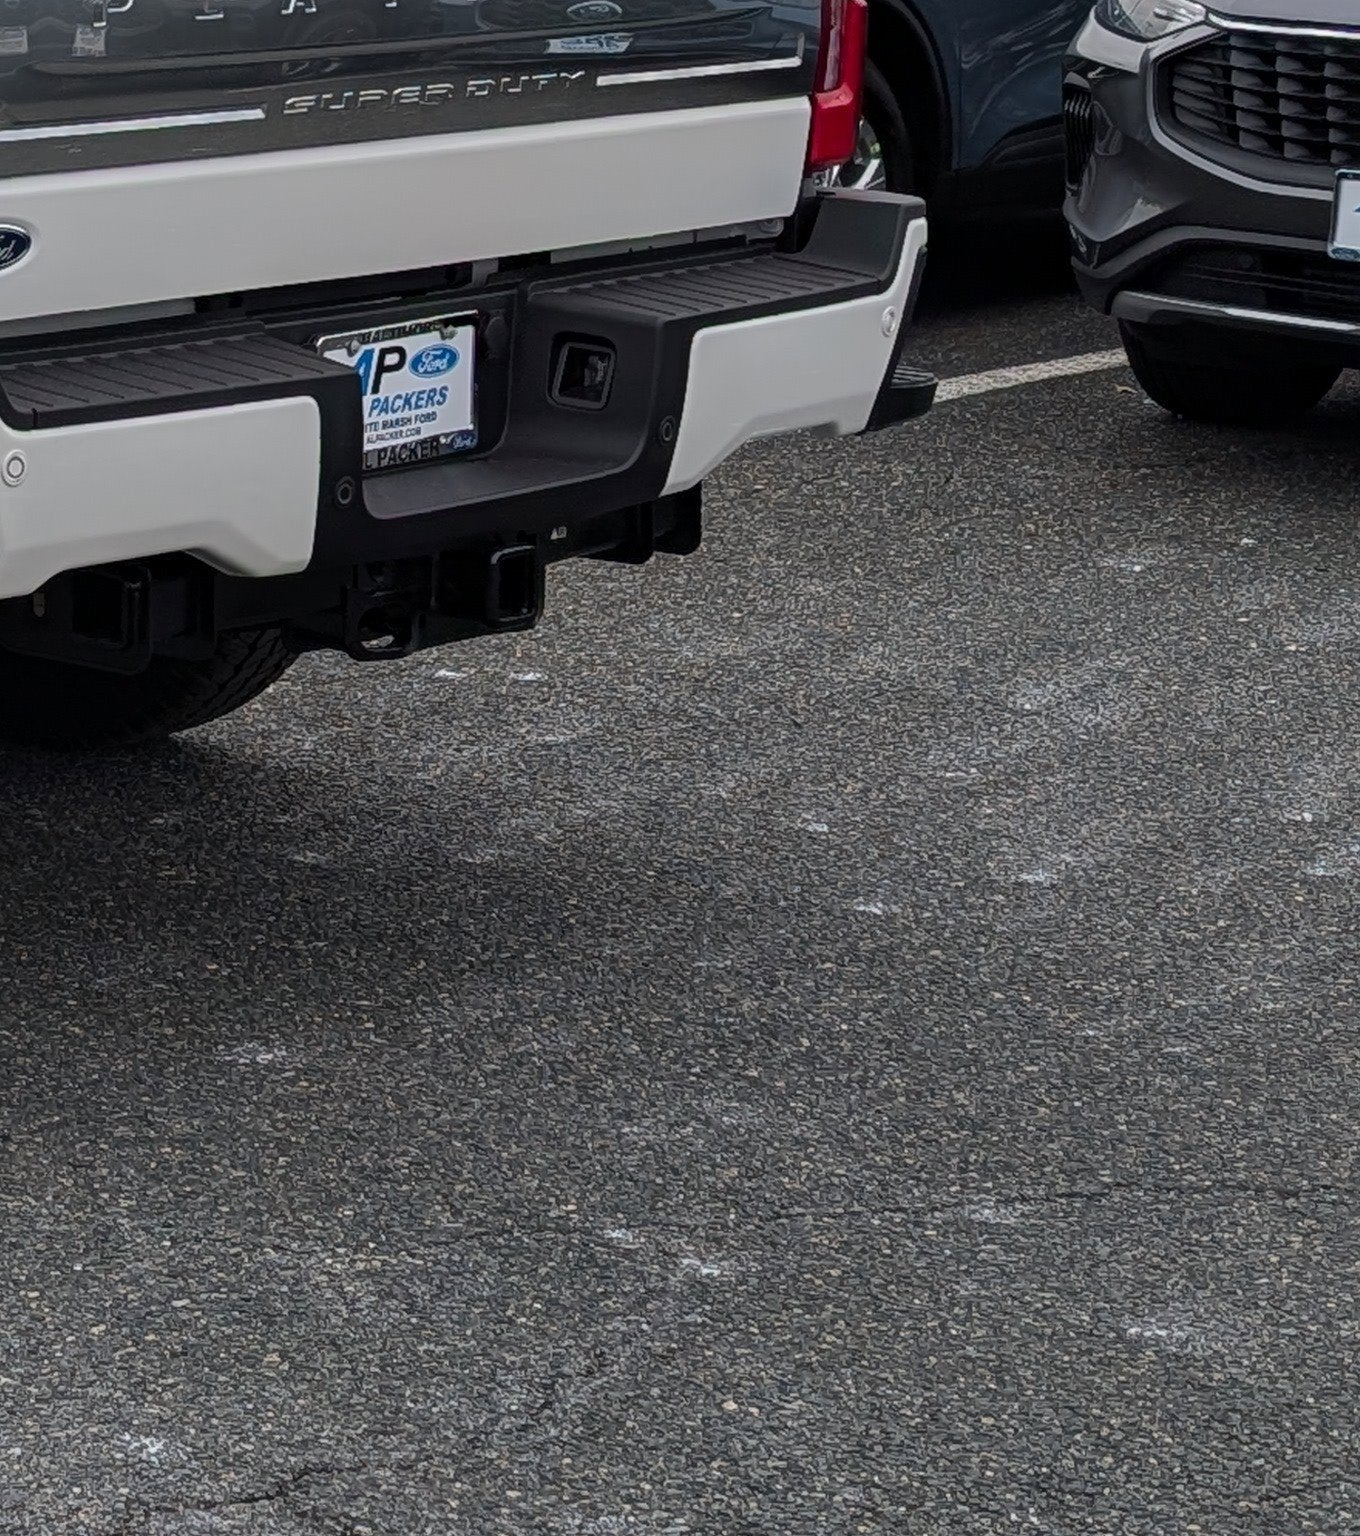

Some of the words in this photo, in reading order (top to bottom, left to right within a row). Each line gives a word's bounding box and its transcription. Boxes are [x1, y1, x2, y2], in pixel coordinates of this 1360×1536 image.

[283, 83, 454, 114] SUPER
[467, 70, 585, 98] DUTY
[368, 385, 449, 417] PACKERS
[414, 411, 437, 424] FORD
[377, 439, 441, 466] PACKER
